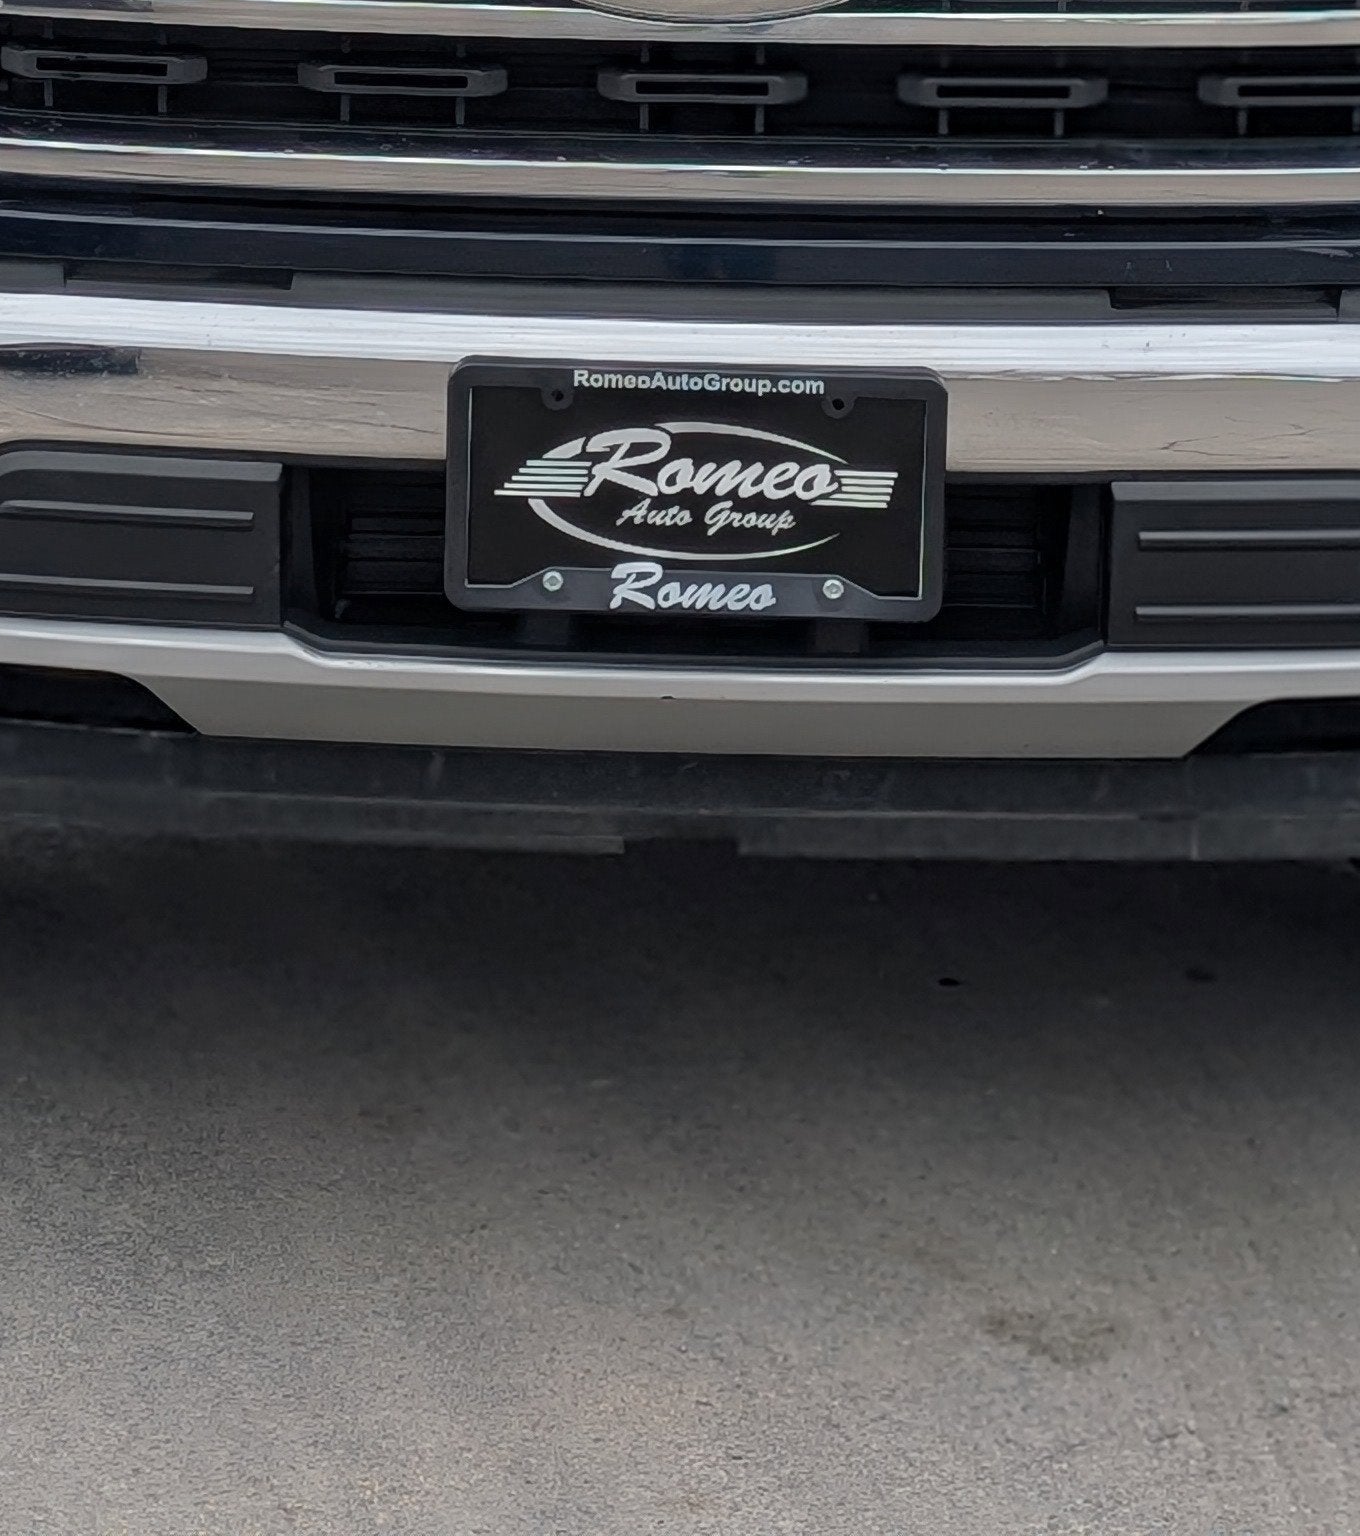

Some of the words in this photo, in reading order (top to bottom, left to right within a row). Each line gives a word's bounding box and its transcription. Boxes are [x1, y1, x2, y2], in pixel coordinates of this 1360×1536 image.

[572, 369, 825, 396] RomeoAutoGroup.com
[582, 426, 840, 501] Romeo
[615, 497, 693, 526] Auto
[704, 501, 797, 536] Group
[609, 561, 777, 612] Romeo
